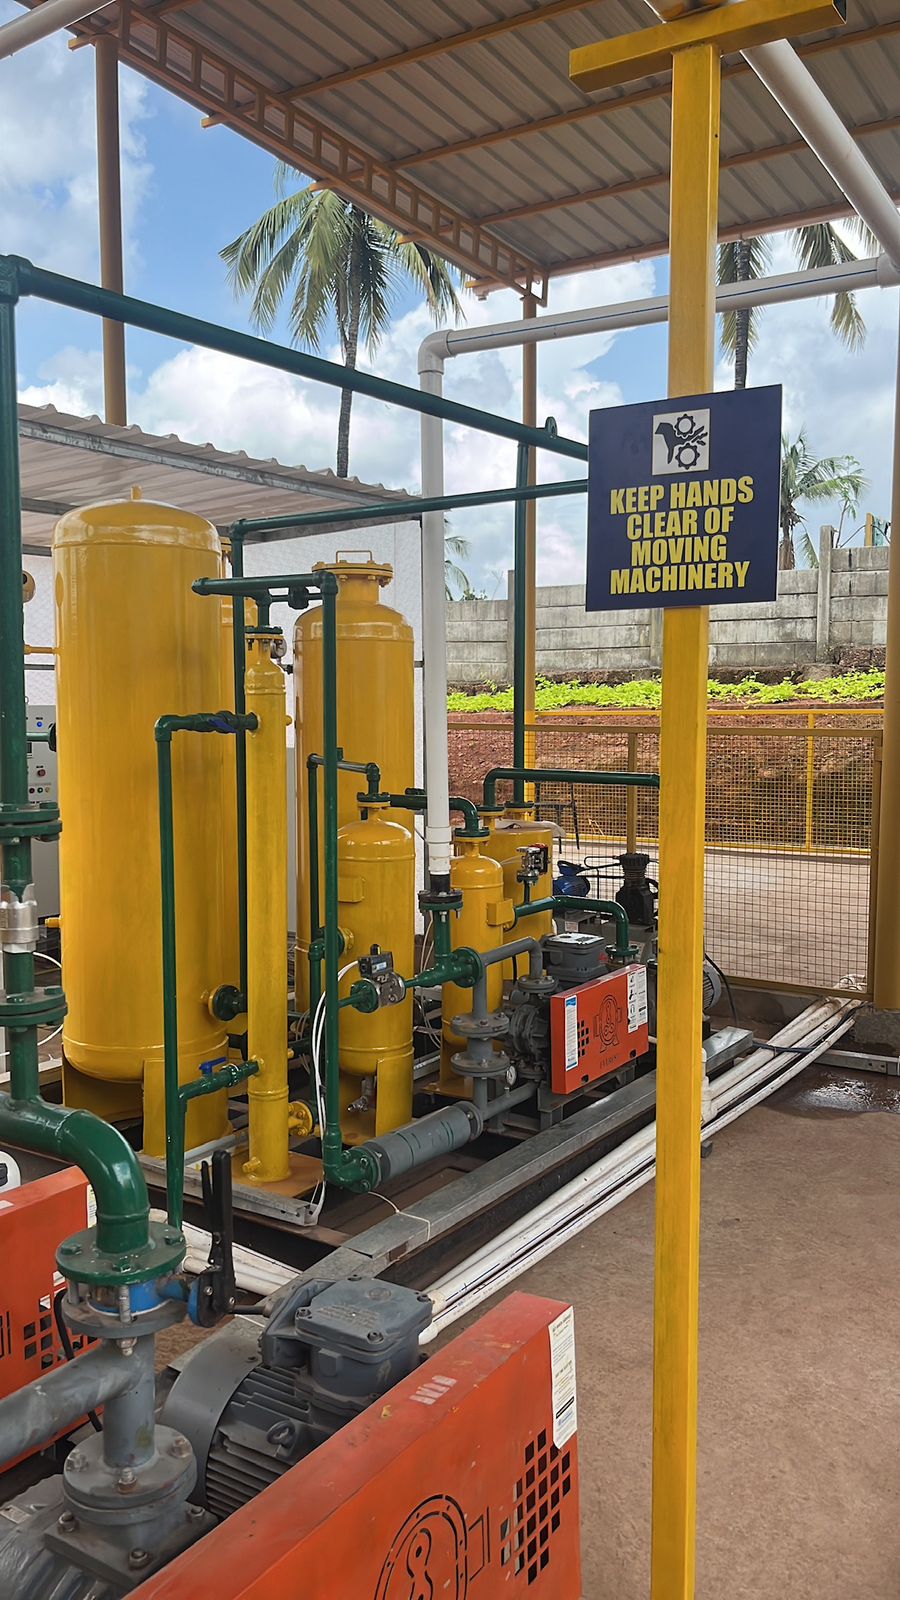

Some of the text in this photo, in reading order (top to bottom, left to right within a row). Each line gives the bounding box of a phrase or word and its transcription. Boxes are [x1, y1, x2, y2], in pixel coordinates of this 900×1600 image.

[610, 476, 754, 515] KEEP HANDS
[627, 506, 735, 540] CLEAR OF
[631, 534, 727, 567] MOVING
[610, 561, 750, 595] MACHINERY
